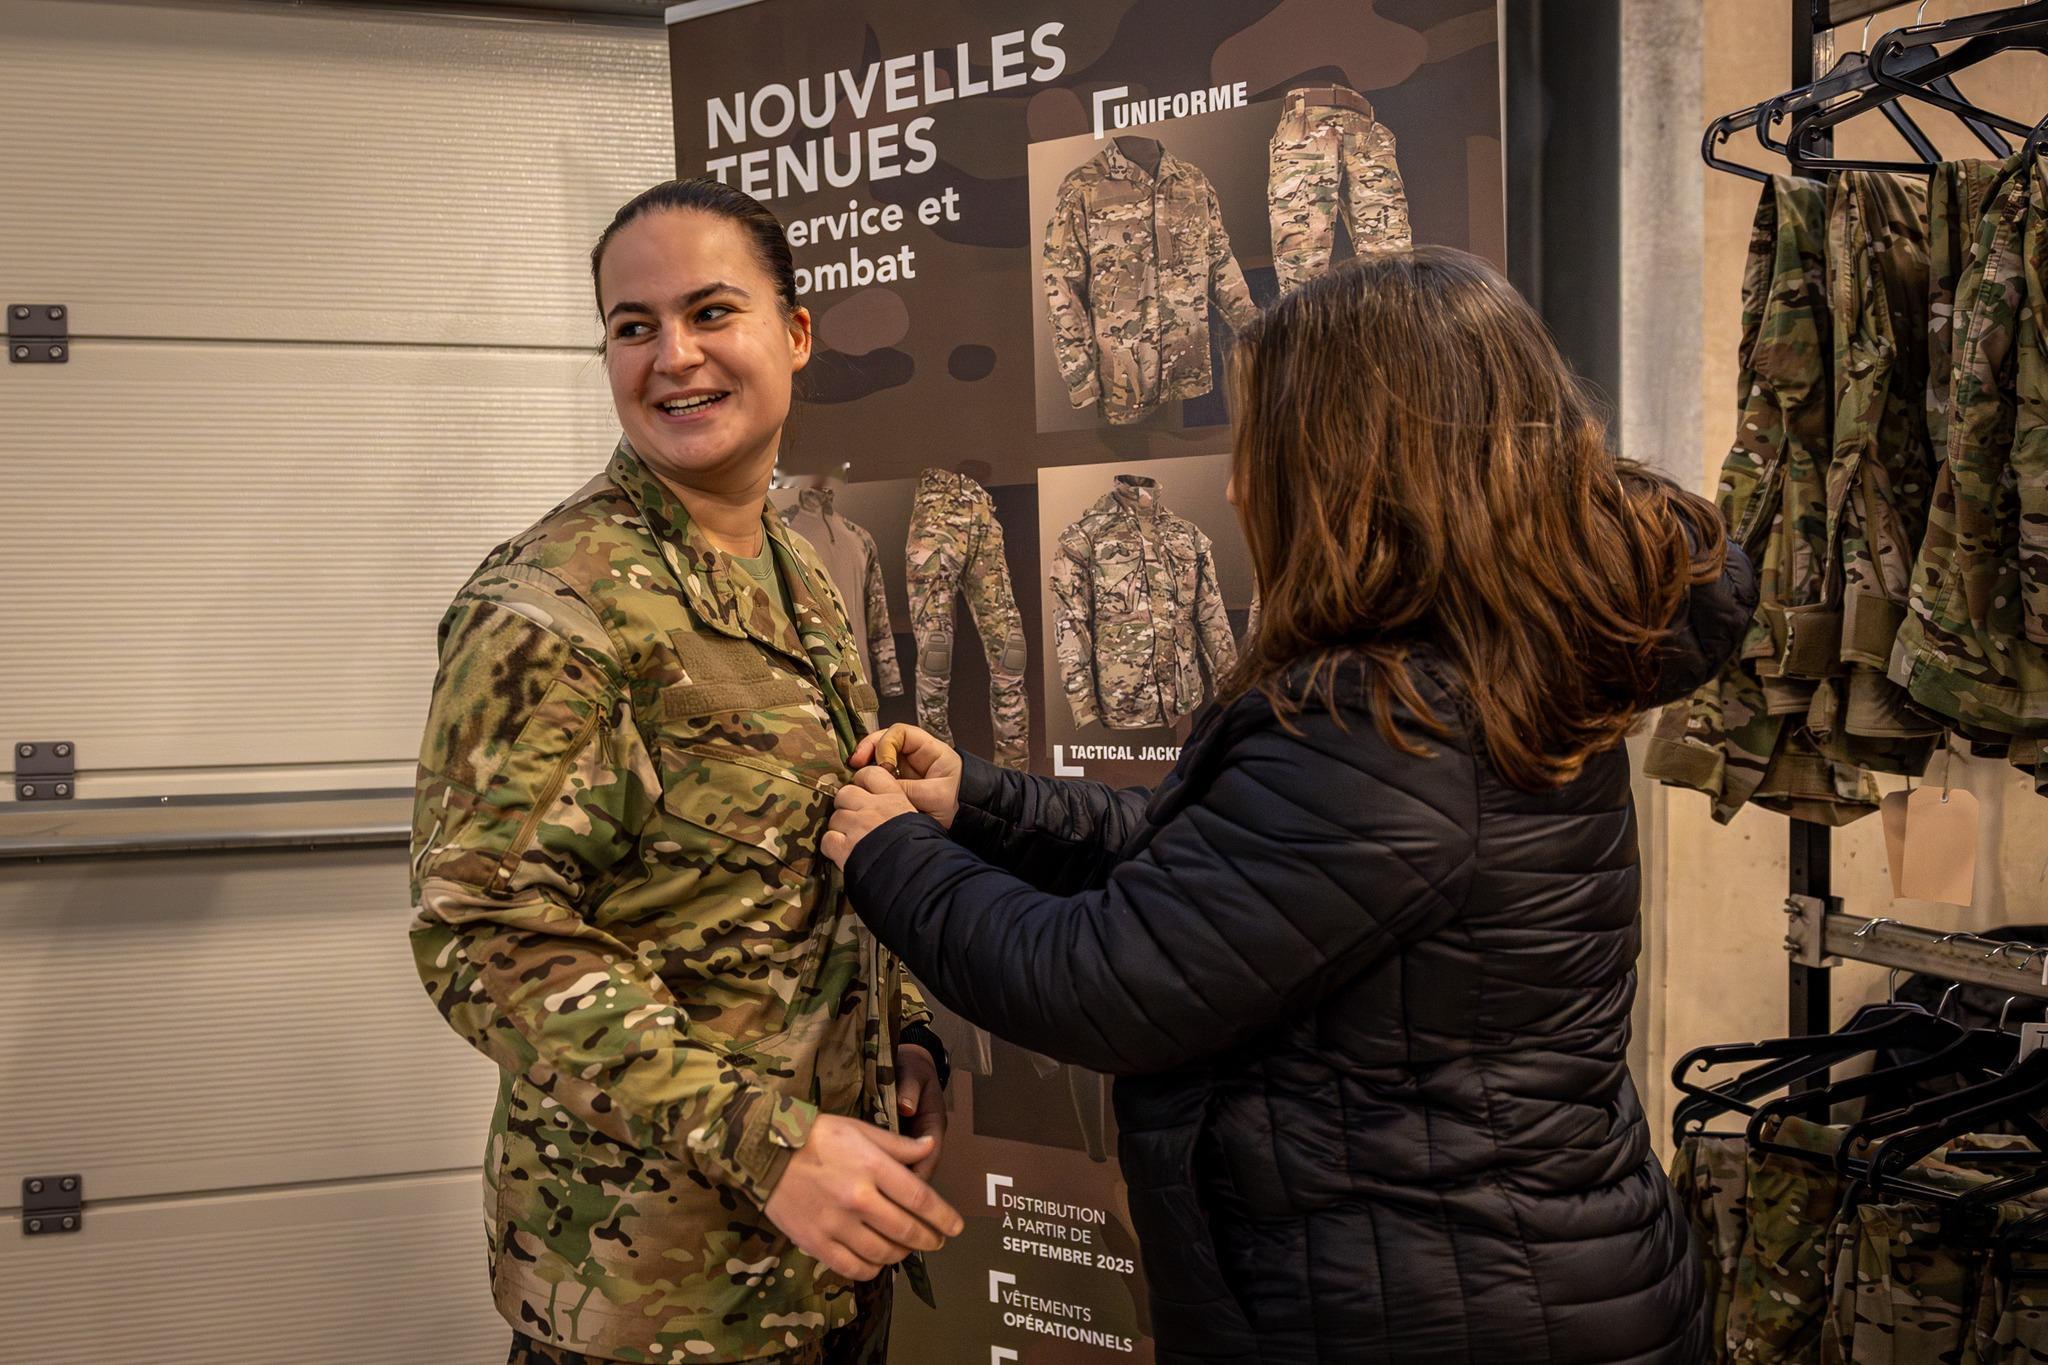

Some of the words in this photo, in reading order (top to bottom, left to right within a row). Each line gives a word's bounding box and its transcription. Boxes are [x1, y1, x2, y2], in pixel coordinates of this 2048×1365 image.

[707, 22, 1066, 149] NOUVELLES
[1113, 81, 1248, 129] UNIFORME
[706, 117, 938, 201] TENUES
[786, 199, 904, 248] ervice
[918, 187, 961, 226] et
[795, 244, 916, 296] ombat
[1069, 745, 1135, 761] TACTICAL
[1002, 1193, 1106, 1225] DISTRIBUTION
[1002, 1211, 1014, 1230] À
[1017, 1217, 1067, 1240] PARTIR
[1070, 1227, 1092, 1245] DE
[1003, 1236, 1093, 1266] SEPTEMBRE
[1096, 1254, 1135, 1275] 2025
[1002, 1289, 1092, 1322] VÊTEMENTS
[1003, 1311, 1133, 1353] OPÉRATIONNELS
